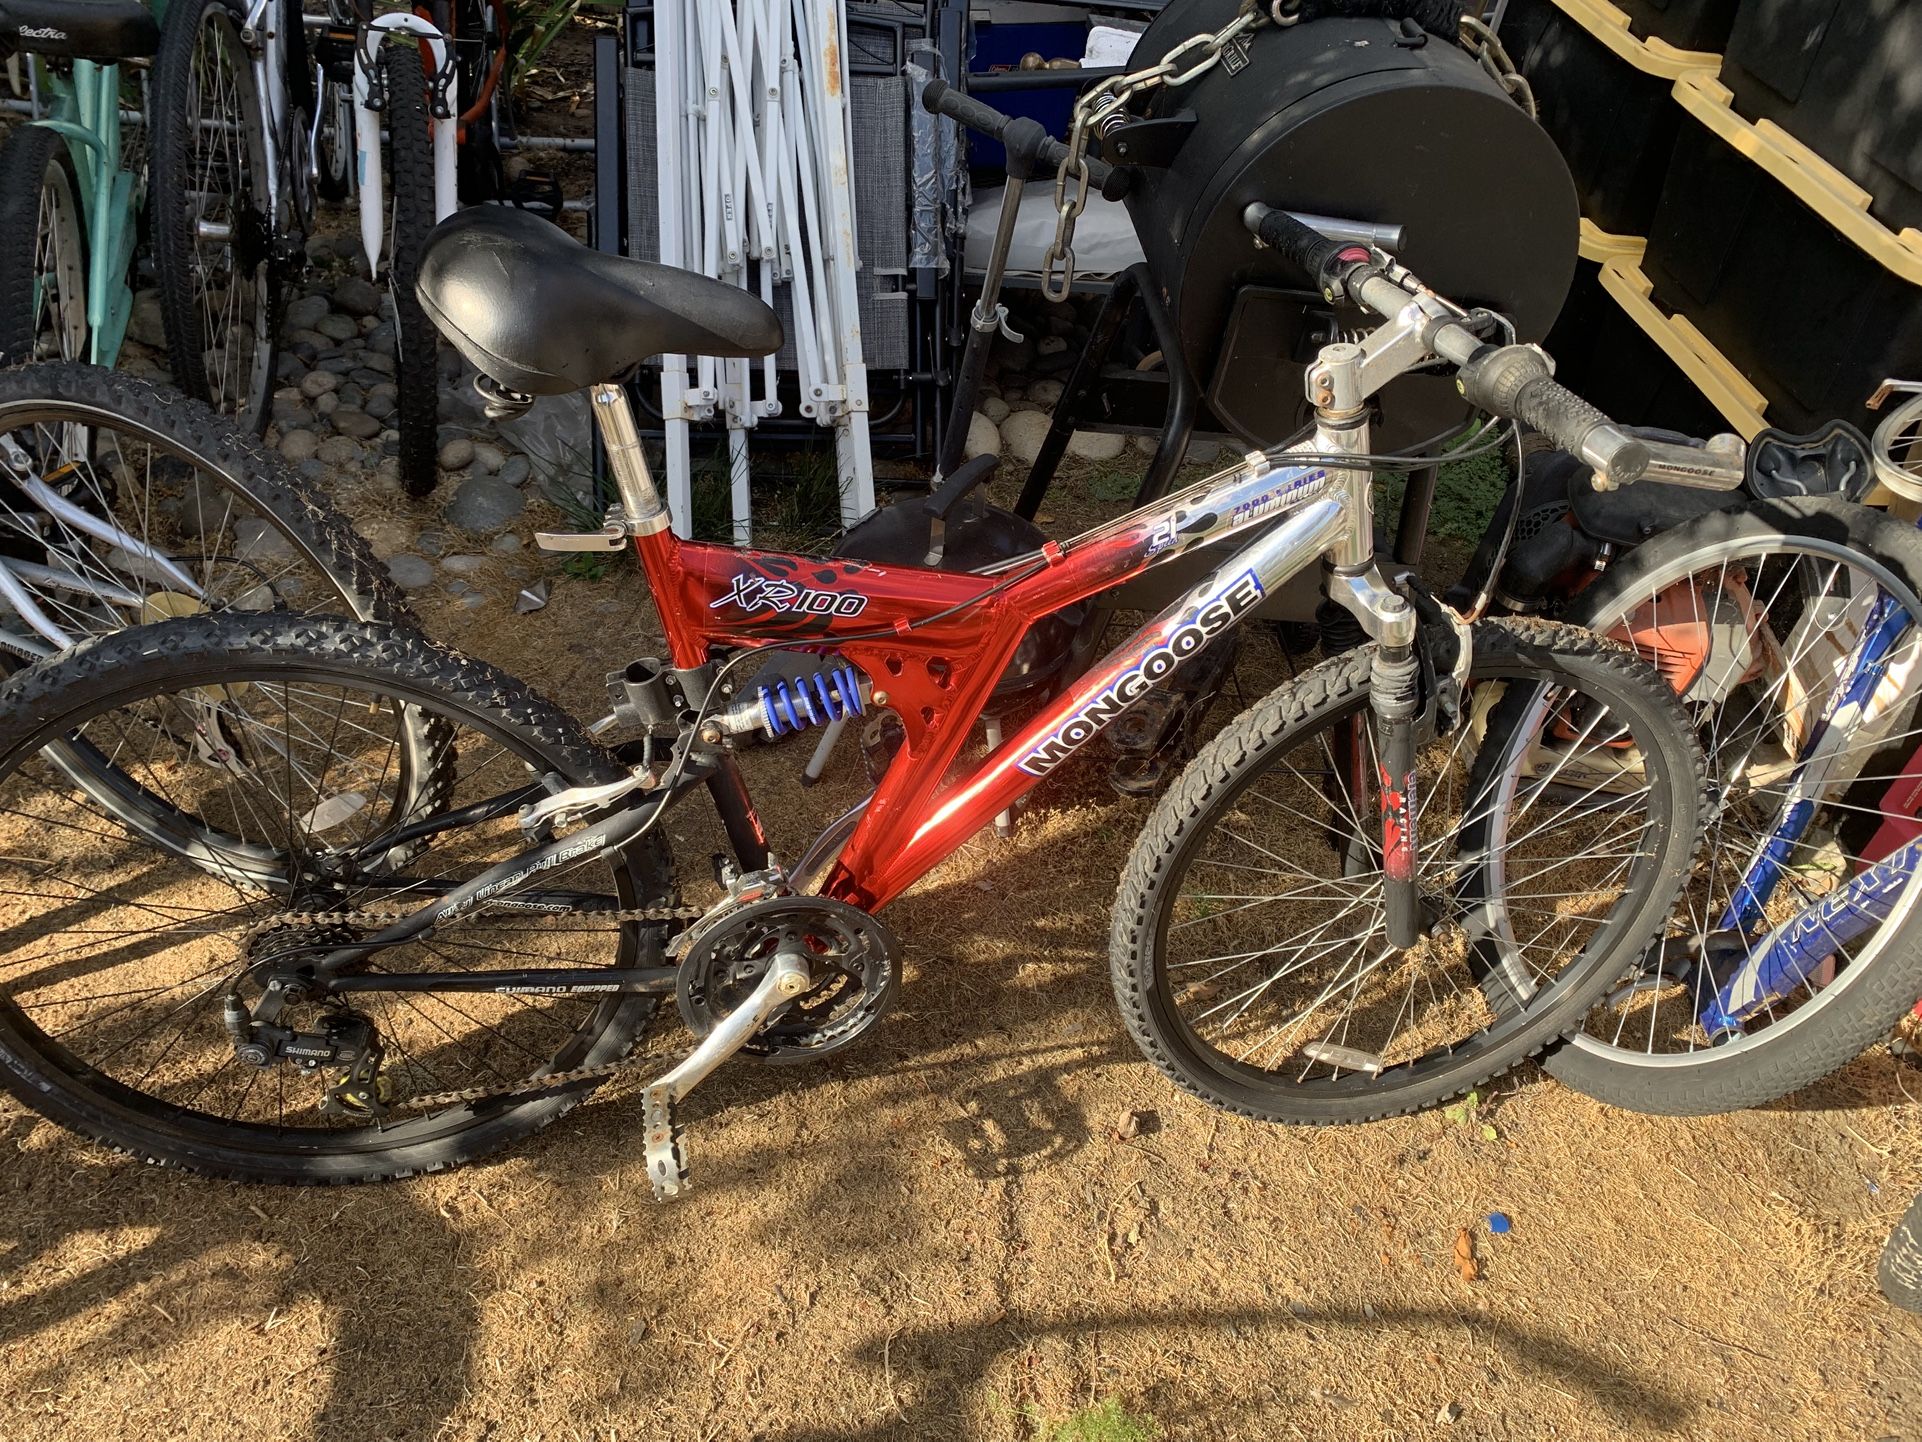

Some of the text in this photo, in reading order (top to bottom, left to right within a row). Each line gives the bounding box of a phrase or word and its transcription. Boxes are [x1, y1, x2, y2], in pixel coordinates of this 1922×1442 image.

[1658, 464, 1716, 477] MONGOOSE
[1233, 469, 1326, 515] 7000 SERIES
[1151, 511, 1178, 546] 21
[1019, 572, 1264, 776] MONGOOSE
[570, 984, 620, 993] EQUIPPED
[285, 1046, 331, 1058] SHIMANO
